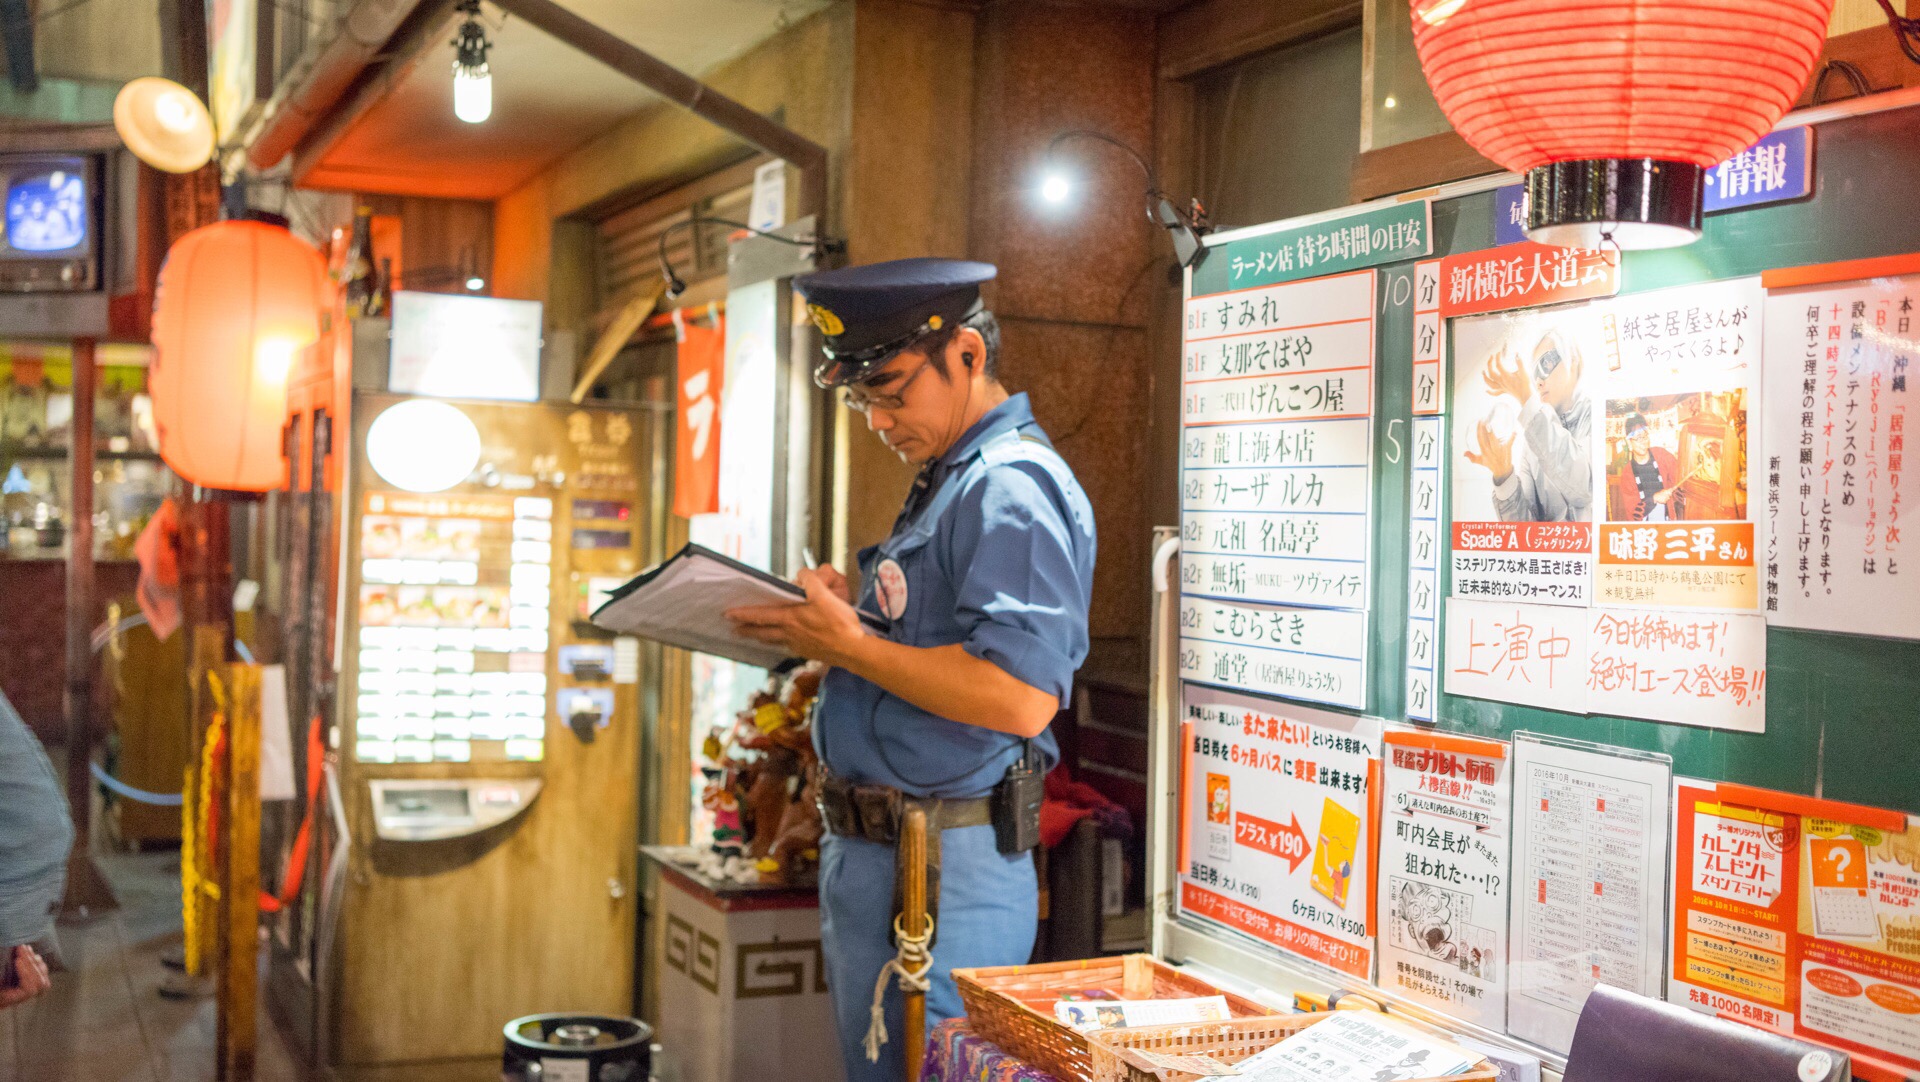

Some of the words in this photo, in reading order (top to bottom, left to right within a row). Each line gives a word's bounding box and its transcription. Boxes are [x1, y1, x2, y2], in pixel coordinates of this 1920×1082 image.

[1704, 143, 1788, 199] 情報
[1231, 245, 1294, 280] ラーメン店
[1296, 218, 1421, 266] 待ち時間の目安
[1382, 273, 1411, 315] 10
[1419, 273, 1436, 304] 分
[1449, 248, 1608, 305] 新横浜大道芸
[1188, 311, 1207, 329] B1F
[1217, 296, 1279, 331] すみれ
[1622, 305, 1748, 341] 紙芝居屋さんが
[1897, 296, 1913, 334] 本日
[1187, 353, 1207, 372] B1F
[1217, 336, 1313, 376] 支那そばや
[1418, 323, 1436, 355] 分
[1186, 394, 1206, 414] B1F
[1215, 377, 1345, 415] 二代目げんこつ屋
[1417, 373, 1434, 405] 分
[1186, 441, 1205, 459] B2F
[1385, 419, 1405, 464] 5
[1418, 430, 1434, 461] 分
[1798, 305, 1821, 600] 何卒ご理解の程お願い申し上げます。
[1819, 303, 1843, 596] 十四時ラストオーダーとなります。
[1185, 481, 1204, 499] B2F
[1213, 473, 1271, 506] カーザ
[1281, 473, 1325, 507] ルカ
[1416, 480, 1433, 511] 分
[1184, 523, 1203, 541] B2F
[1211, 519, 1247, 551] 元祖
[1259, 519, 1320, 554] 名島亭
[1415, 530, 1432, 561] 分
[1534, 538, 1583, 550] ジャグリング
[1538, 525, 1578, 537] コンタクト
[1609, 528, 1658, 562] 味野
[1766, 456, 1780, 612] 新横浜ラーメン博物館
[1183, 565, 1202, 584] B2F
[1455, 558, 1587, 575] ミステリアスな水晶玉さばき!
[1413, 579, 1431, 611] 分
[1459, 579, 1582, 599] 近未来的なパフォーマンス!
[1181, 609, 1202, 628] B2F
[1213, 608, 1305, 645] こむらさき
[1412, 628, 1429, 660] 分
[1594, 613, 1729, 657] 今日も締めます!
[1454, 609, 1571, 689] 上演中
[1181, 651, 1201, 671] B2F
[1213, 651, 1248, 685] 通堂
[1586, 652, 1765, 707] 絶対エース登場!!
[1411, 677, 1428, 709] 分
[1393, 749, 1495, 786] 怪盗ナルト仮面
[1397, 820, 1471, 855] 町内会長が
[1474, 840, 1499, 867] またまた
[1701, 873, 1772, 899] スタンプラリー
[1689, 988, 1780, 1027] 先着1000名限定!
